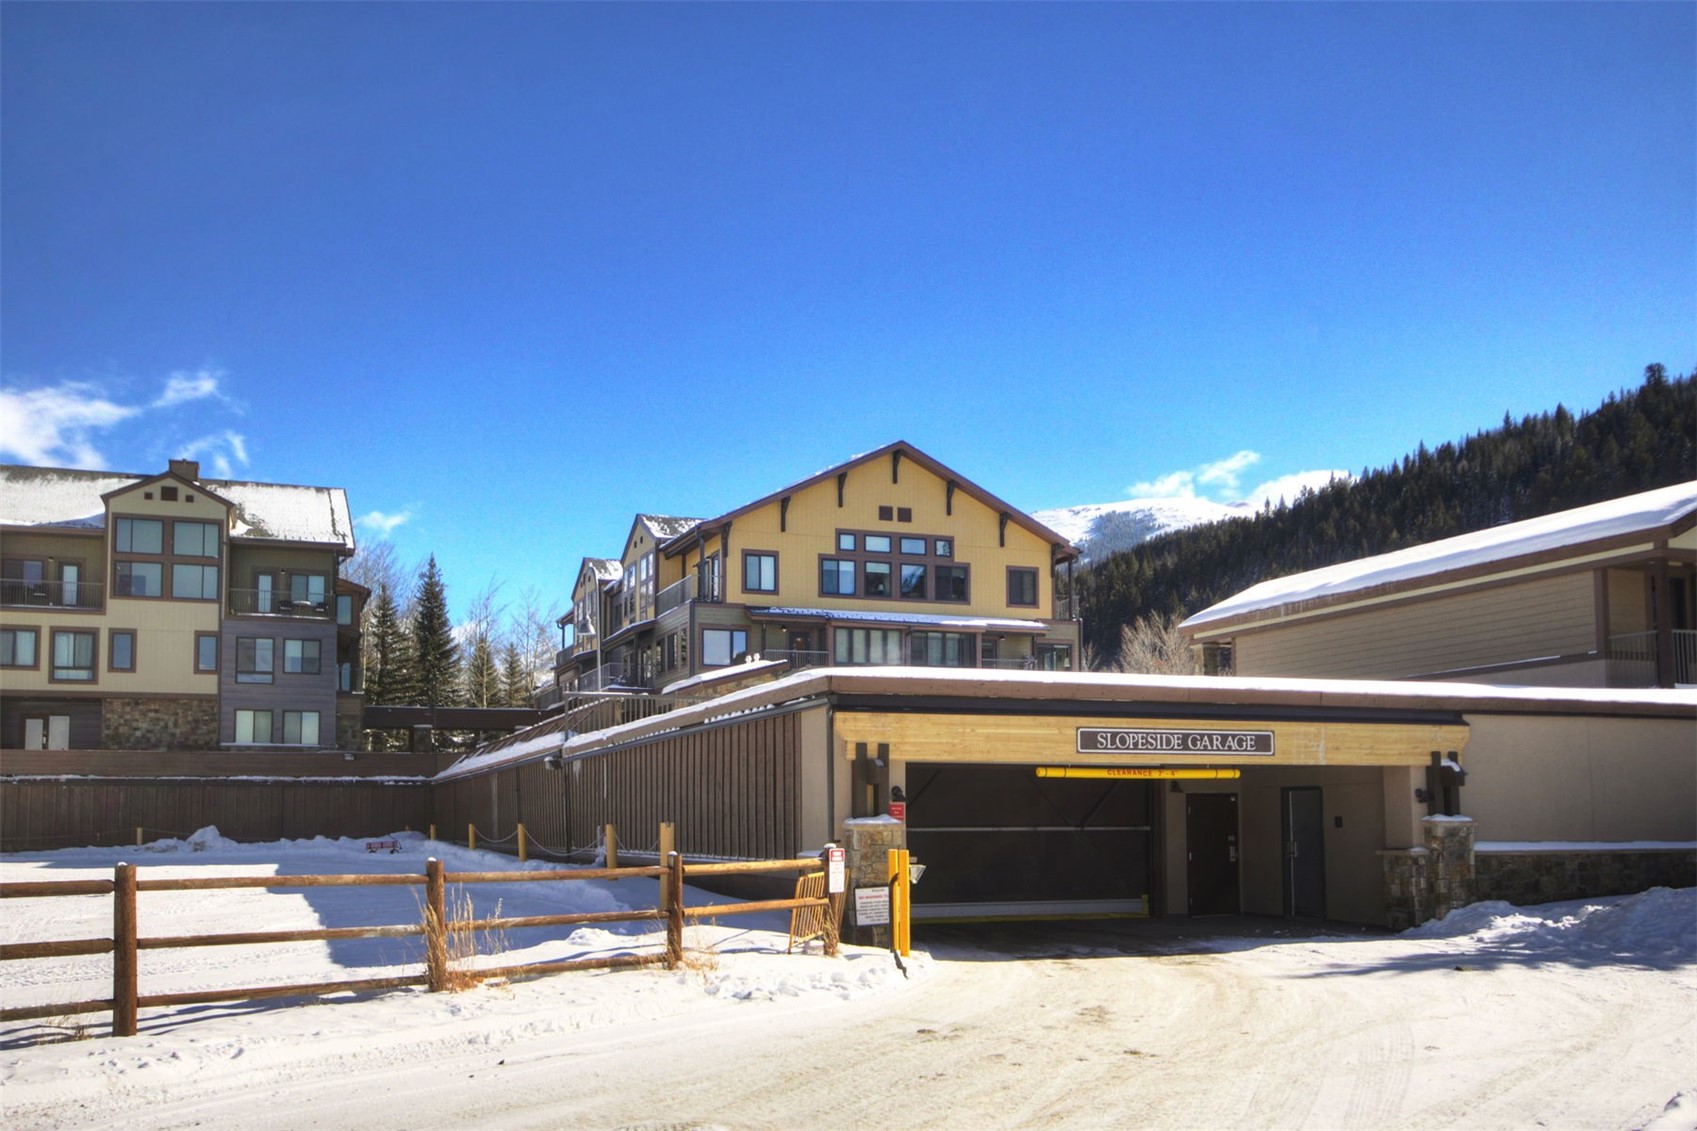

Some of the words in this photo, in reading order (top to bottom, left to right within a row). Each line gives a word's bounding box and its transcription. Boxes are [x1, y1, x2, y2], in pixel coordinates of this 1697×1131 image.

[1097, 732, 1183, 749] SLOPESIDE
[1188, 734, 1256, 751] GARAGE
[1106, 769, 1153, 777] CLEARANCE
